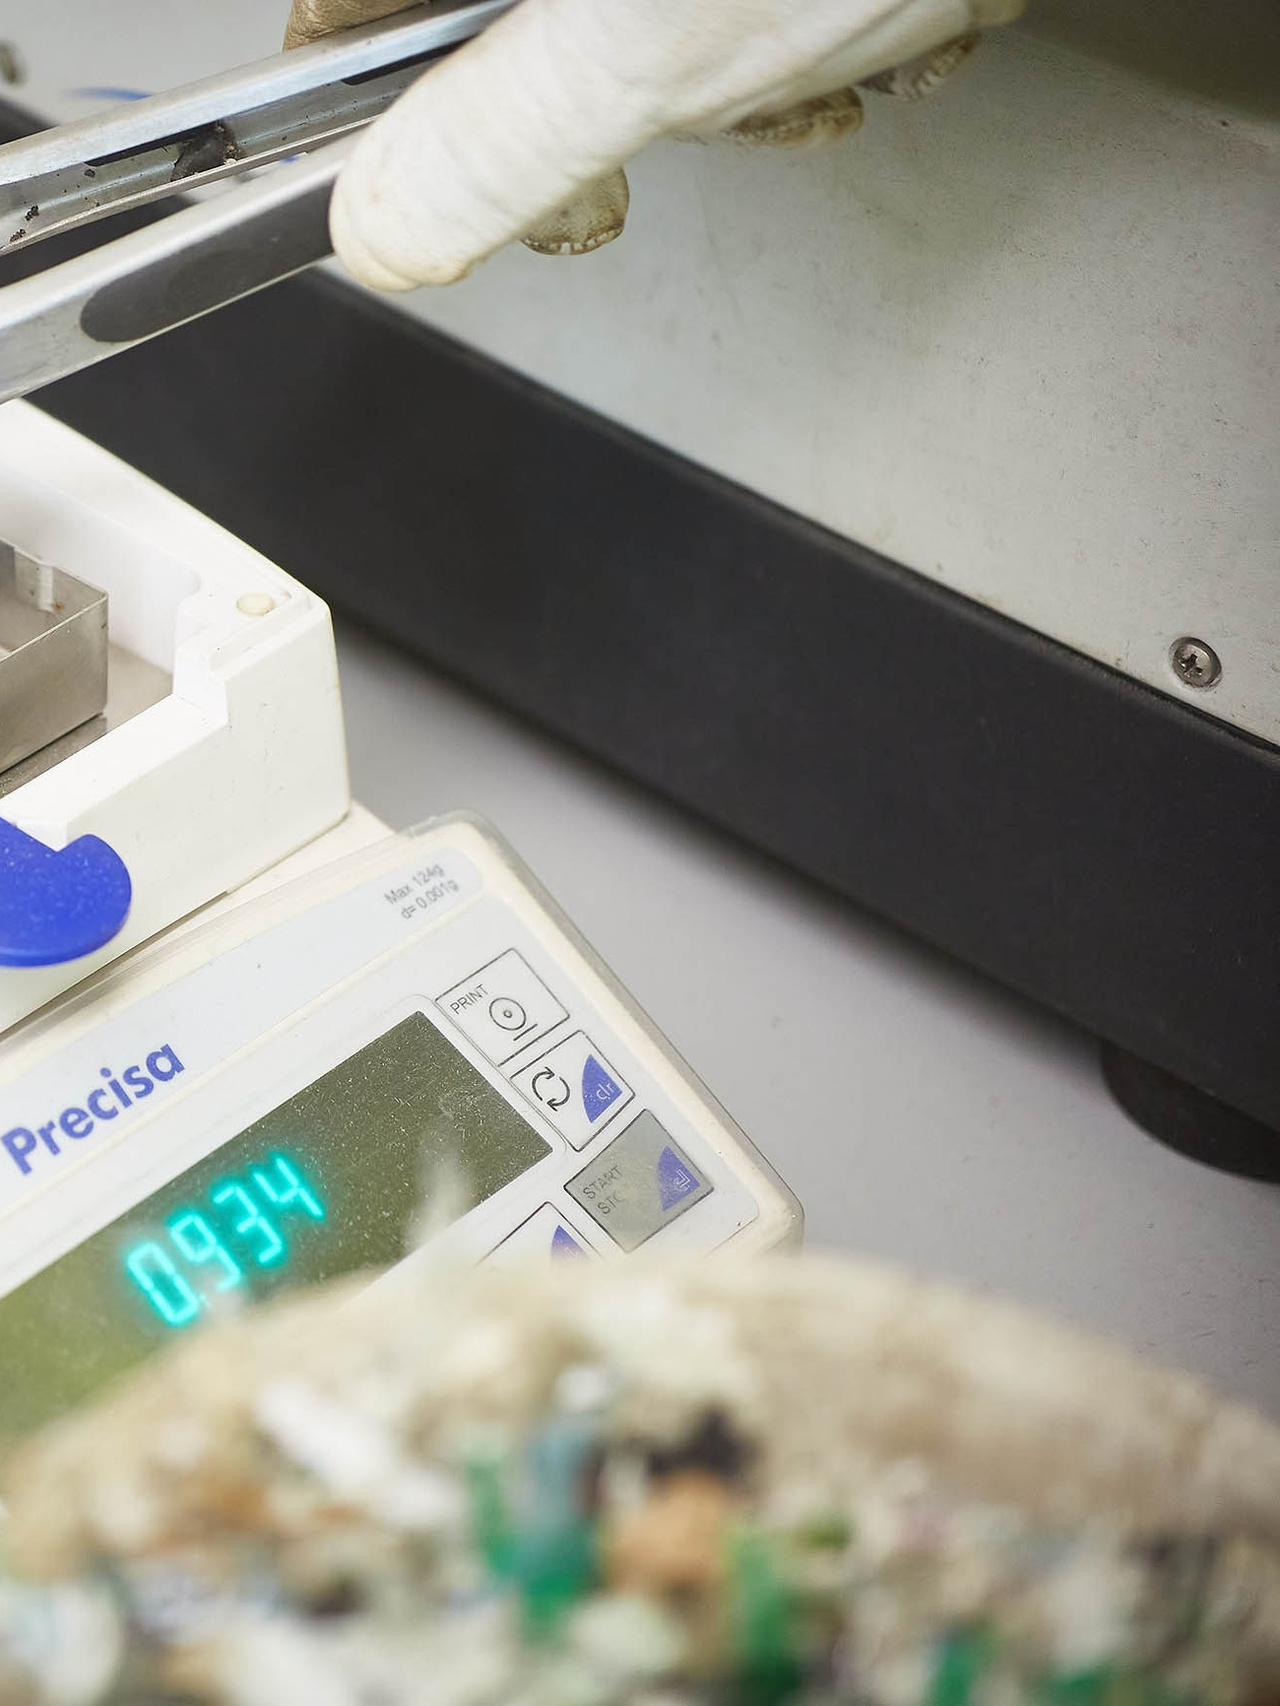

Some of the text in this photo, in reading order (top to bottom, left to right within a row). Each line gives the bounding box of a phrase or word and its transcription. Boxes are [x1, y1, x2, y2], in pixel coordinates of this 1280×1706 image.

[384, 865, 444, 905] Max 124g
[450, 984, 489, 1014] PRINT
[596, 1083, 615, 1100] clr
[0, 1044, 185, 1175] Precisa
[583, 1165, 622, 1199] START
